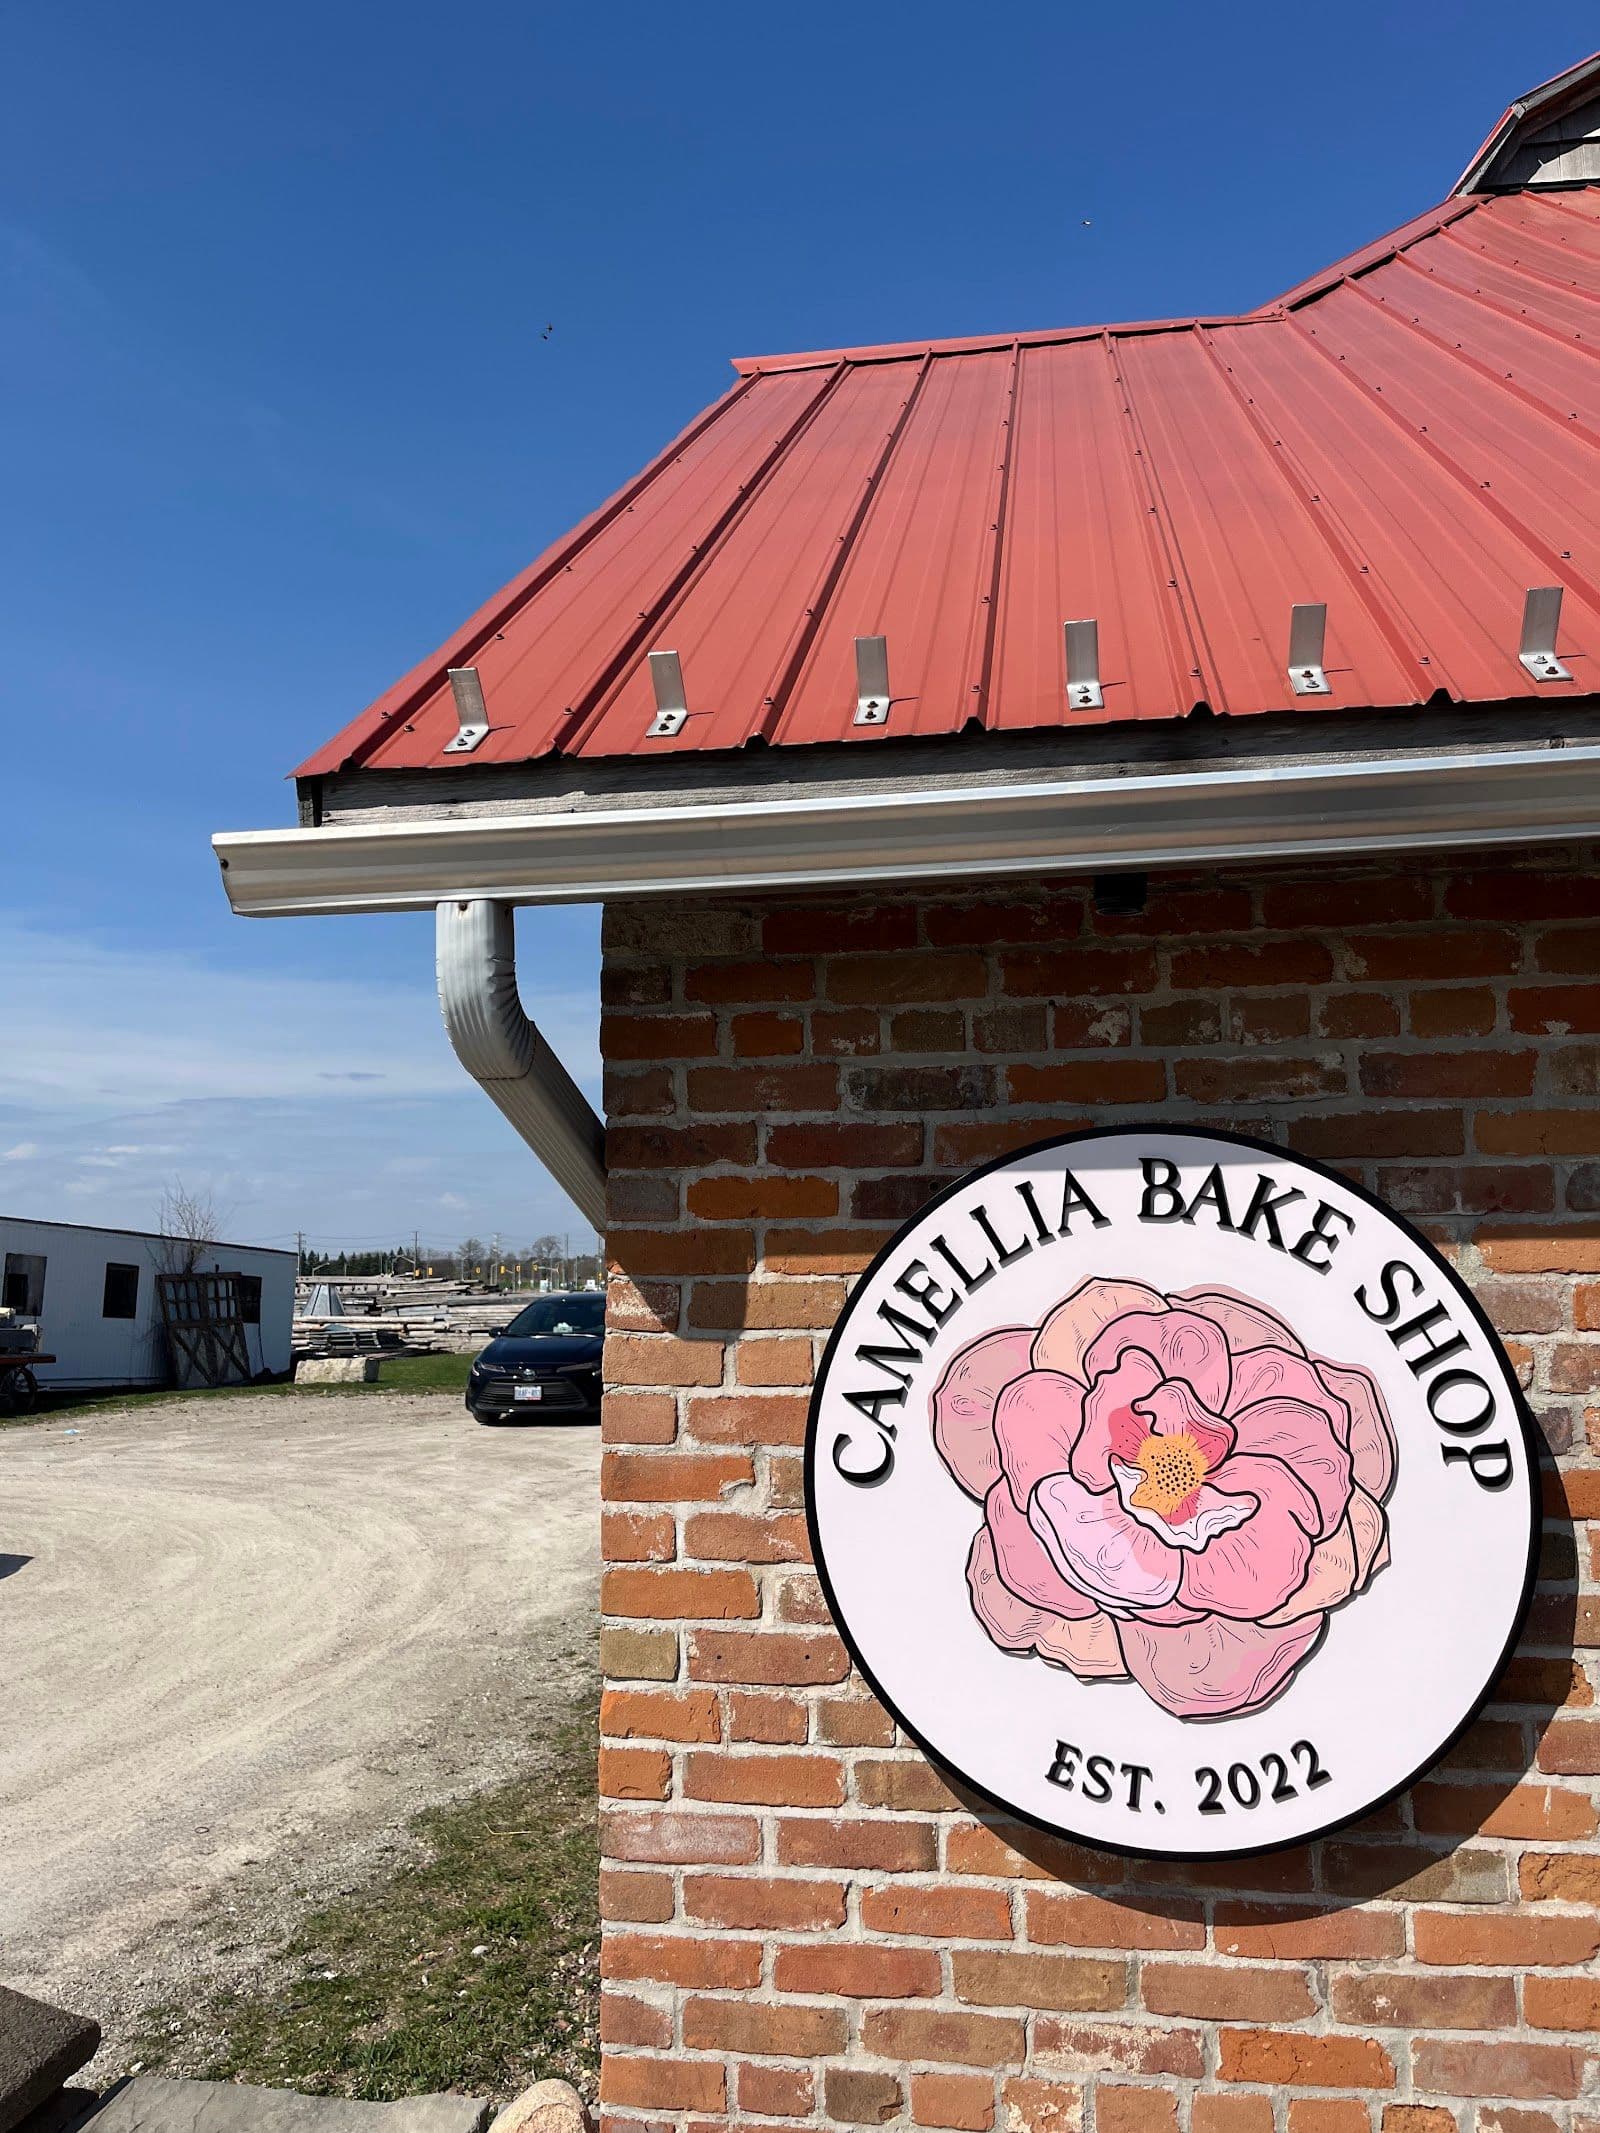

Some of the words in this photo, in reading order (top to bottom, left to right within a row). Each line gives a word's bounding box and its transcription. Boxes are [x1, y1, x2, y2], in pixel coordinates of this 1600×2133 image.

[834, 1168, 1108, 1488] CAMELLIA
[1137, 1157, 1356, 1275] BAKE
[1354, 1259, 1514, 1492] SHOP
[1044, 1739, 1167, 1814] EST.
[1194, 1738, 1333, 1816] 2022
